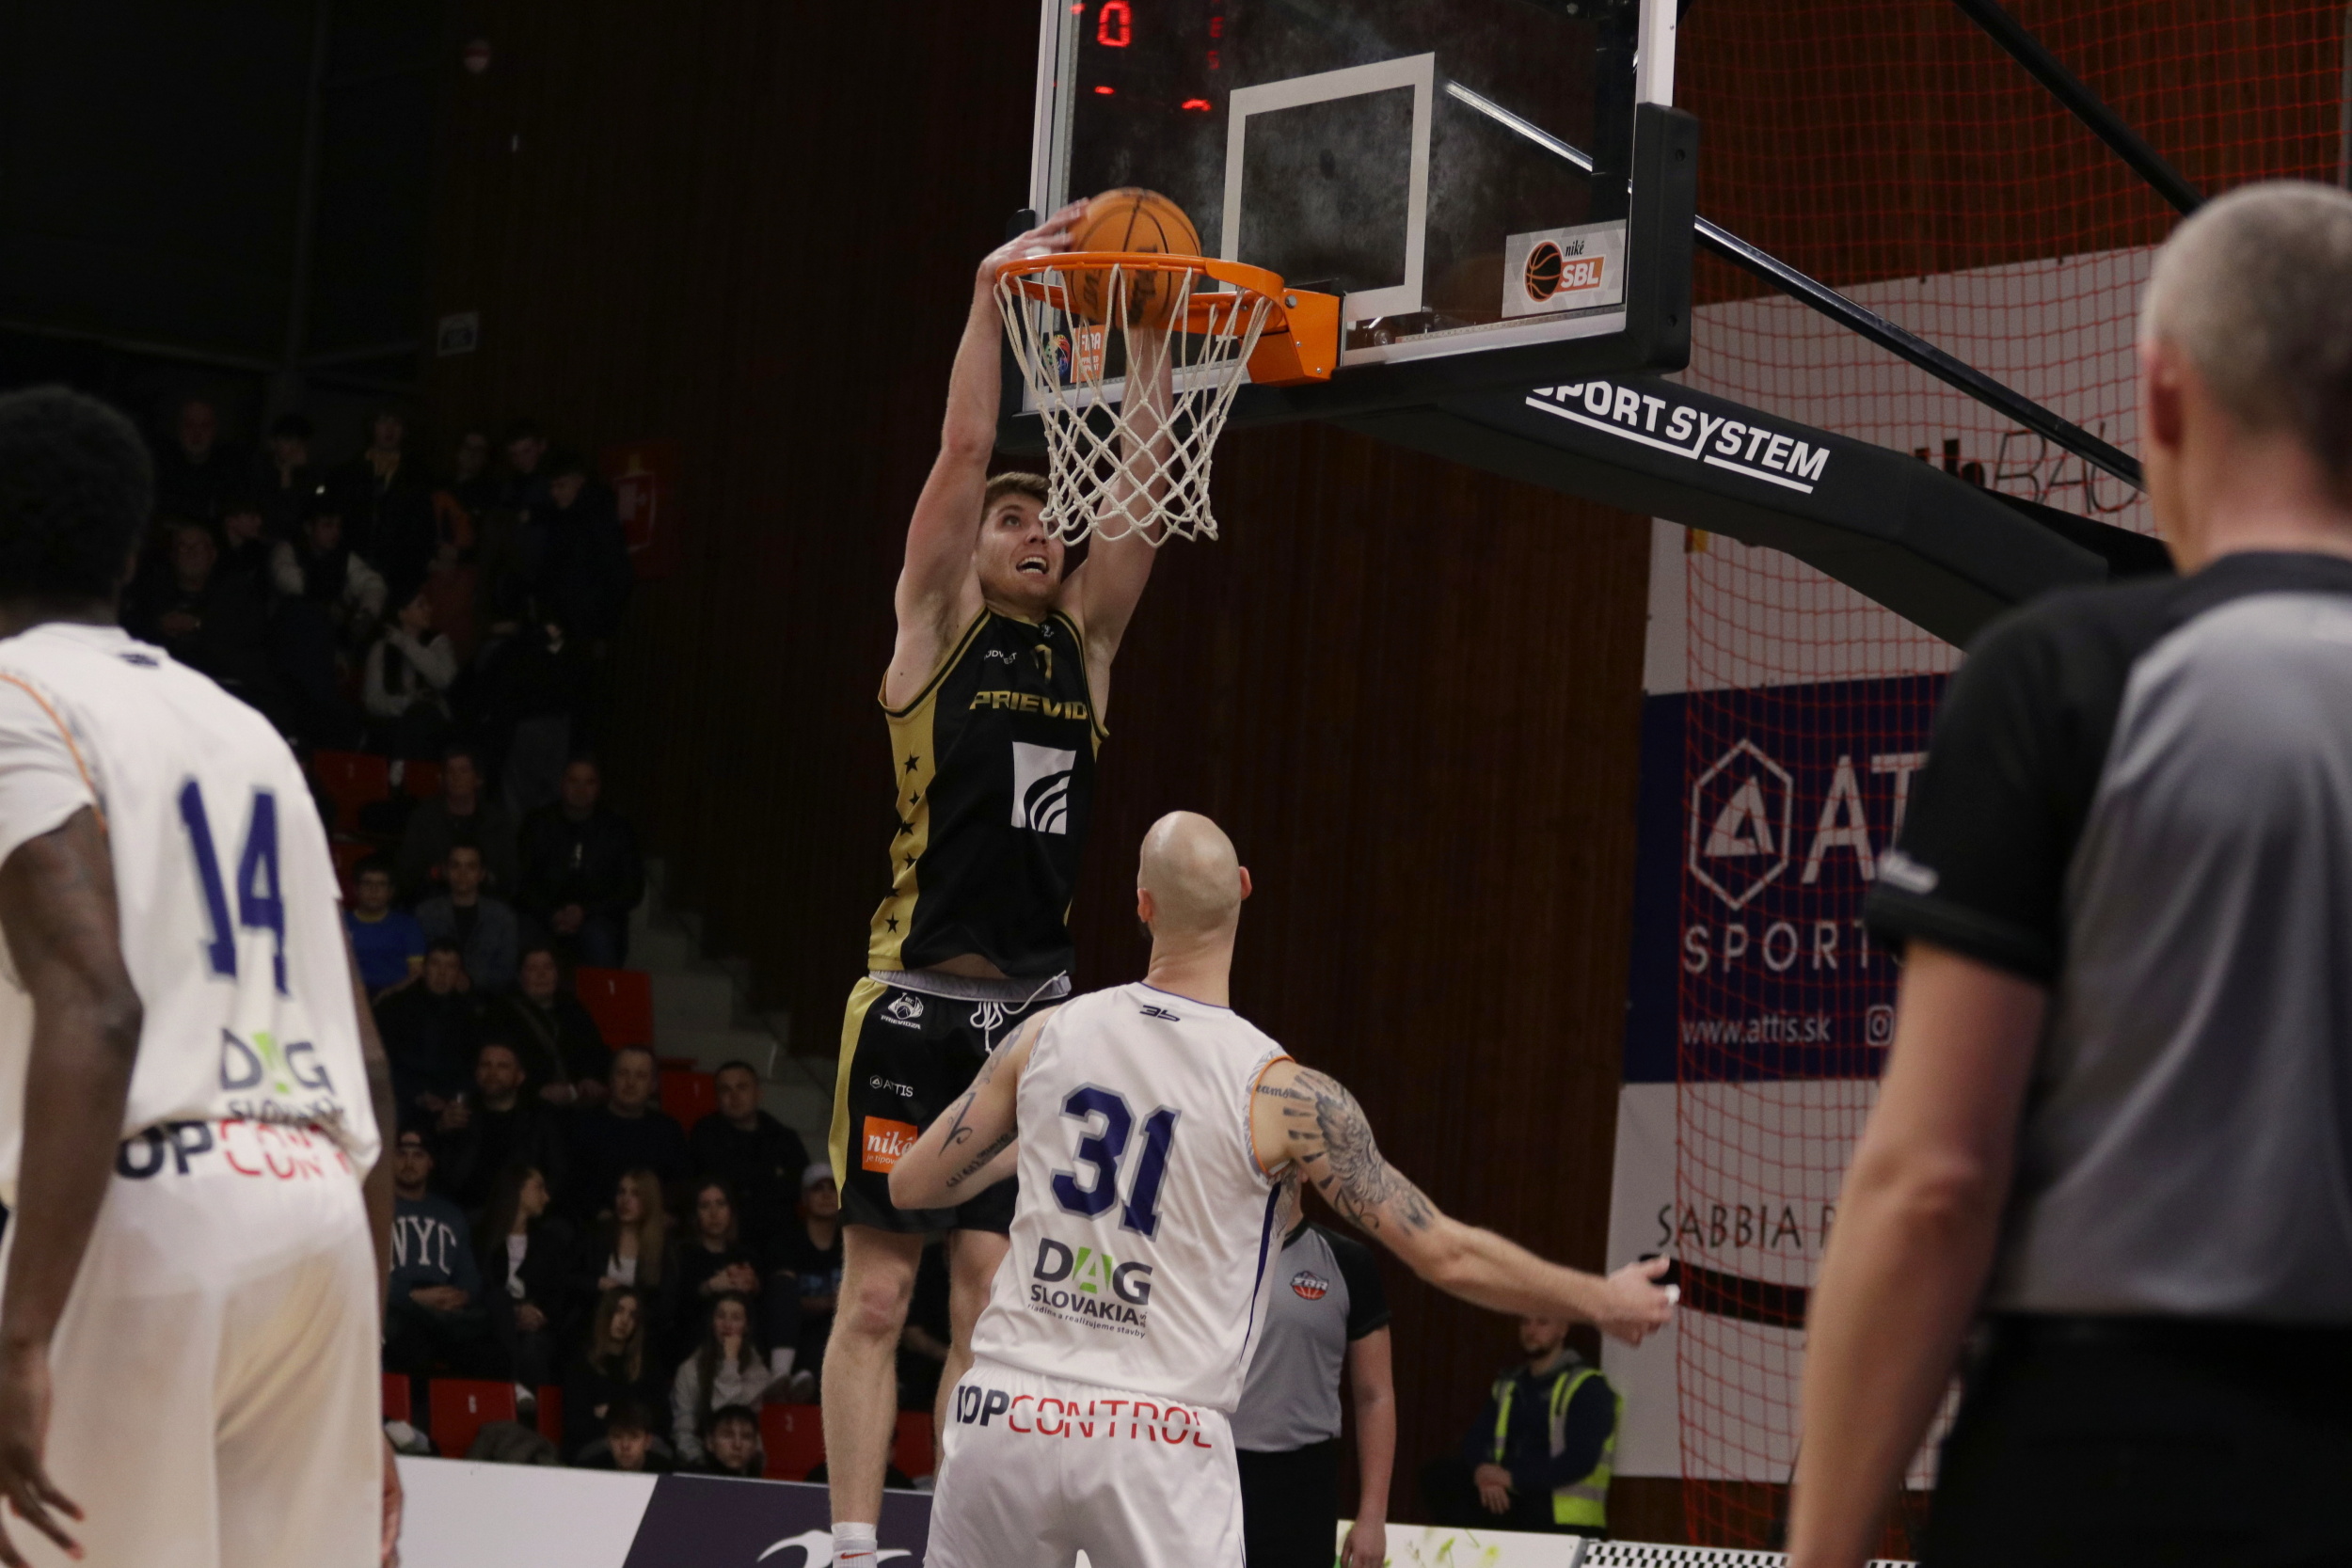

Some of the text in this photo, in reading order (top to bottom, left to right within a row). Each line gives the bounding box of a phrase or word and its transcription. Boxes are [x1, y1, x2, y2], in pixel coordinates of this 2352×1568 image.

[1565, 240, 1585, 257] niké
[1561, 261, 1599, 289] SBL
[1533, 380, 1831, 482] PORT SYSTEM
[177, 772, 290, 1001] 14
[1683, 920, 1902, 974] SPORT
[880, 1014, 922, 1031] PRIEVIDZA
[1682, 1011, 1832, 1045] www.attis.sk
[882, 1079, 914, 1098] ATTIS
[875, 1154, 896, 1165] tipov
[1050, 1081, 1182, 1242] 31
[1658, 1204, 1802, 1249] SABBIA
[1033, 1237, 1153, 1306] DAG
[1030, 1284, 1139, 1326] SLOVAKIA
[1065, 1314, 1115, 1332] realizujeme
[1117, 1325, 1146, 1339] stavby
